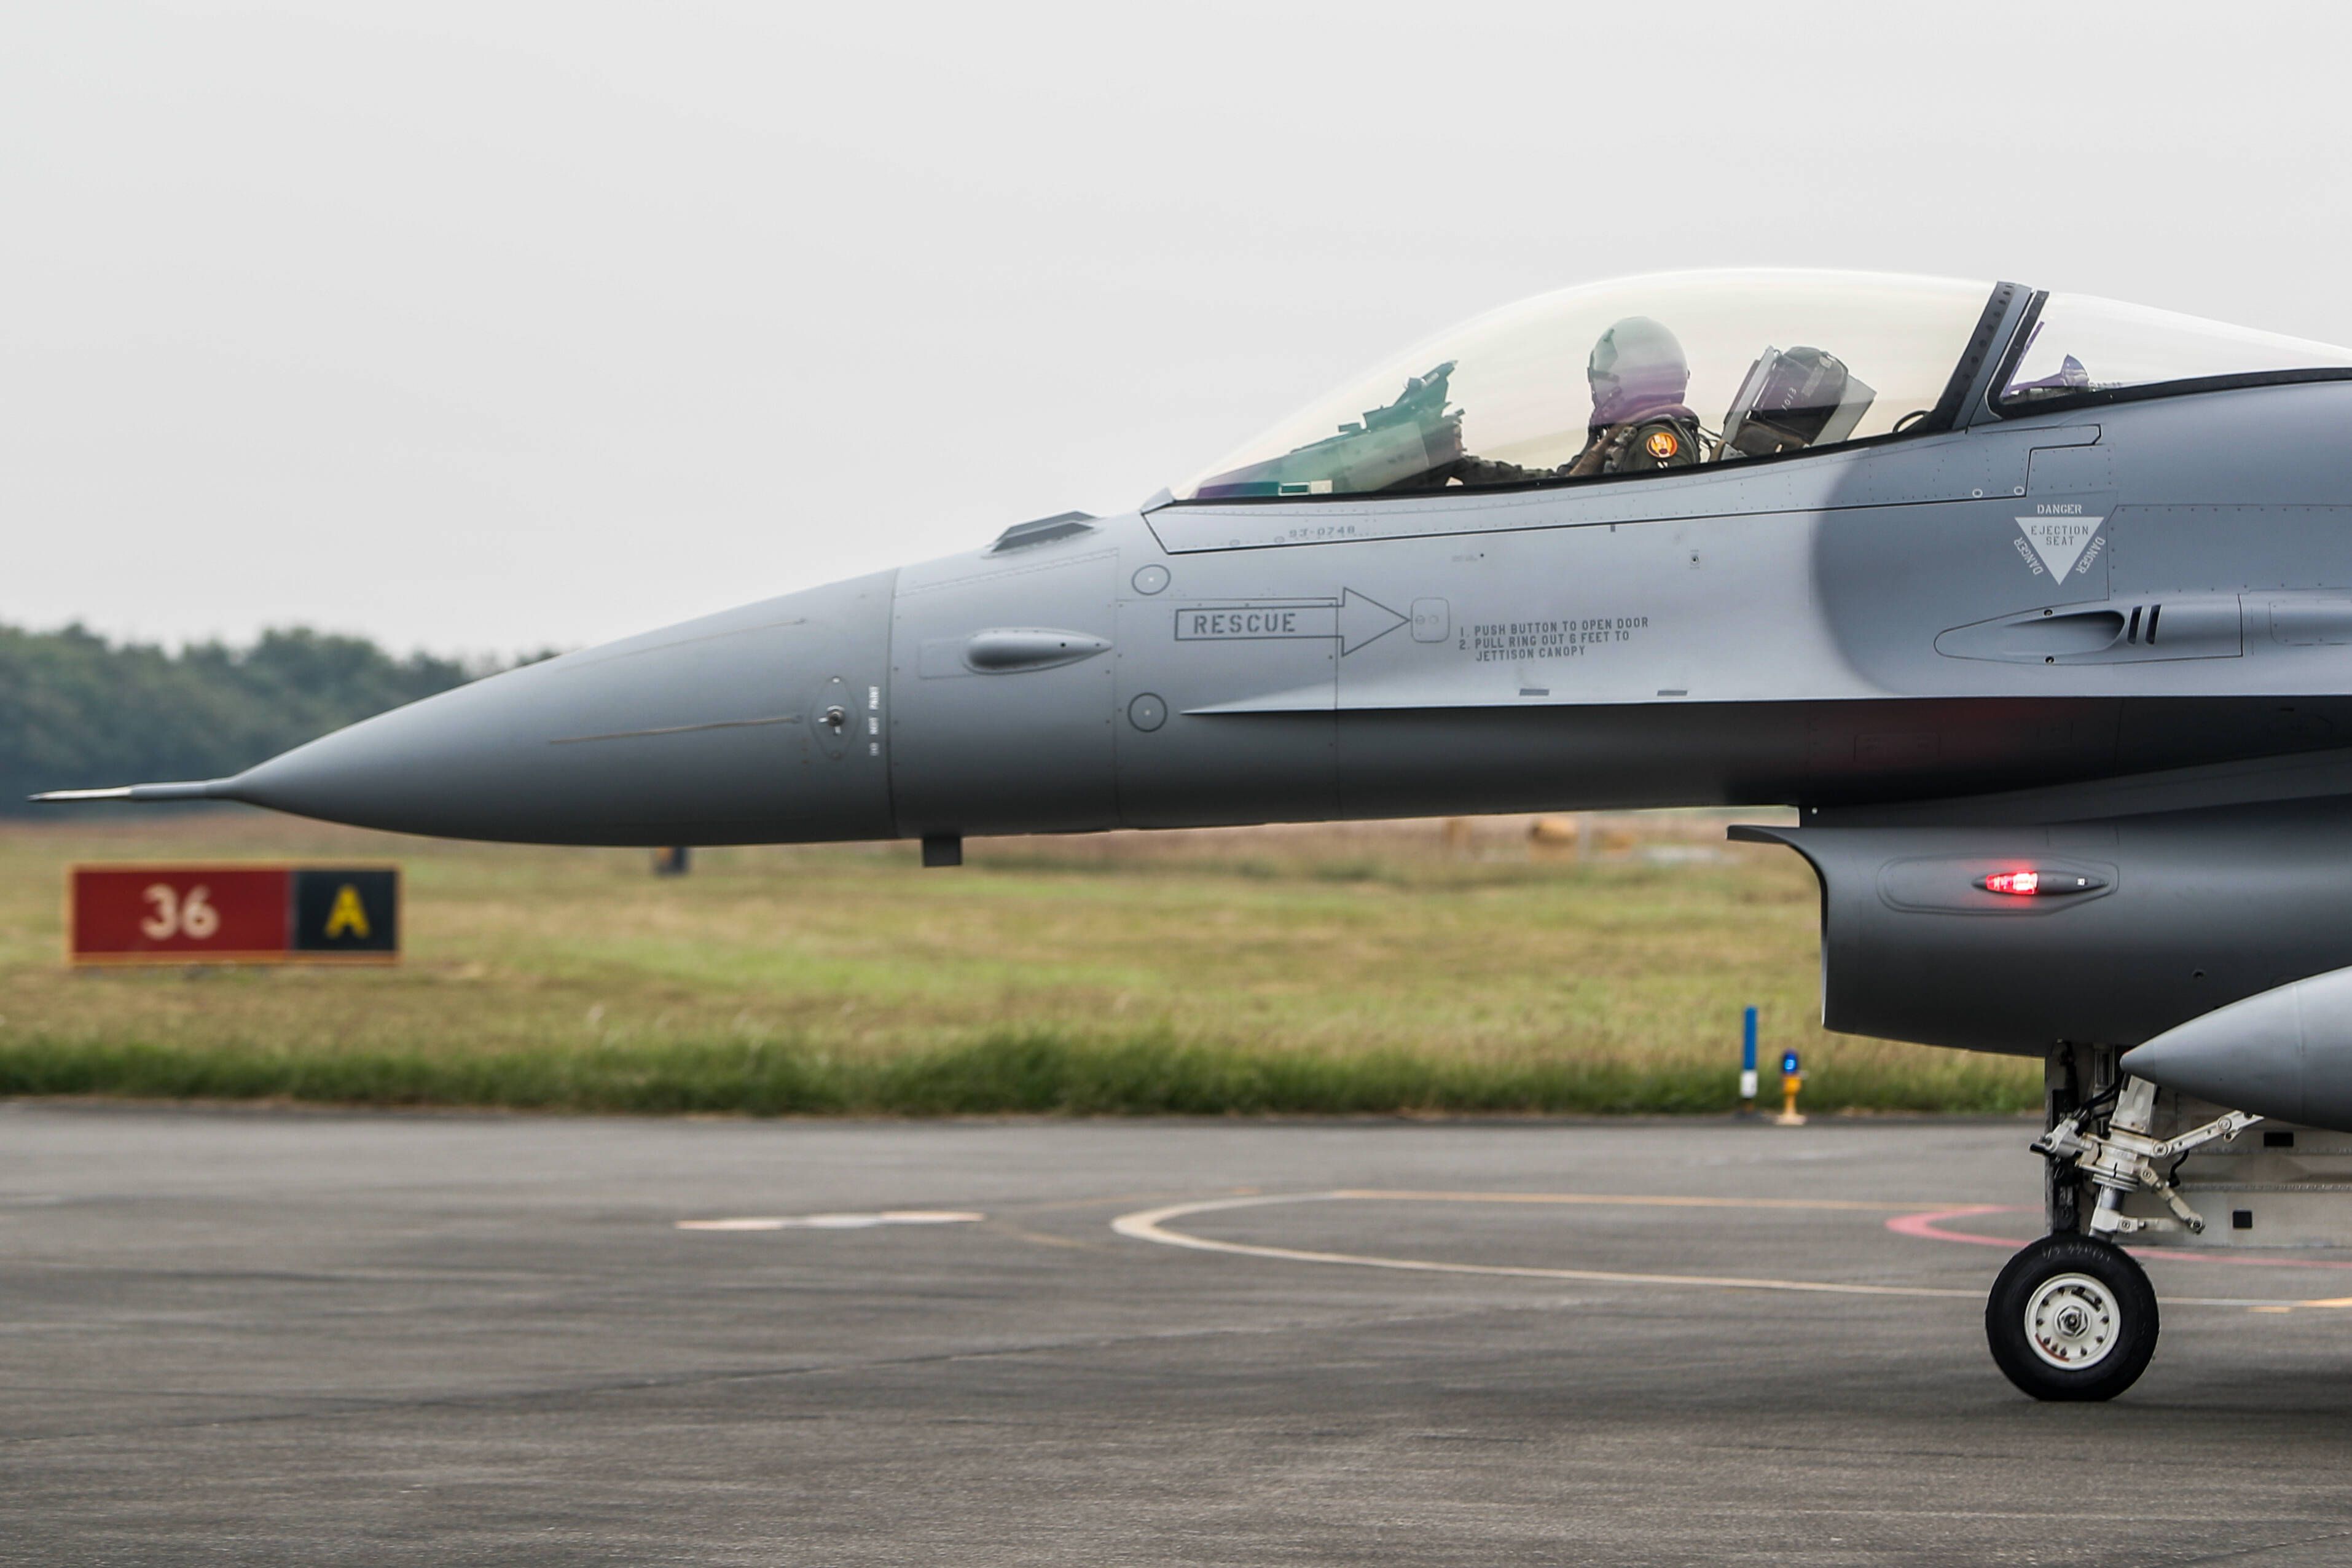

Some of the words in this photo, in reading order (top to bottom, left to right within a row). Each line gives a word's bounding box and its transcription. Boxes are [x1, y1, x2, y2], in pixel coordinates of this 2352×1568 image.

[1781, 387, 1797, 411] 1013
[2037, 504, 2082, 514] DANGER
[2031, 525, 2089, 535] EJECTION
[2046, 536, 2074, 546] SEAT
[2014, 537, 2044, 575] DANGER
[2076, 536, 2106, 574] DANGER
[1194, 613, 1296, 634] RESCUE
[1475, 624, 1505, 637] PUSH
[1510, 621, 1558, 635] BUTTON
[1562, 620, 1577, 632] TO
[1582, 619, 1612, 631] OPEN
[1617, 617, 1649, 629] DOOR
[1459, 639, 1470, 651] 2.
[1475, 637, 1504, 649] PULL
[1508, 635, 1536, 647] RING
[1542, 633, 1564, 645] OUT
[1581, 631, 1610, 643] FEET
[1615, 630, 1629, 641] TO
[1475, 649, 1535, 662] JETTISON
[1539, 645, 1586, 658] CANOPY
[141, 883, 220, 940] 36
[323, 884, 370, 939] A
